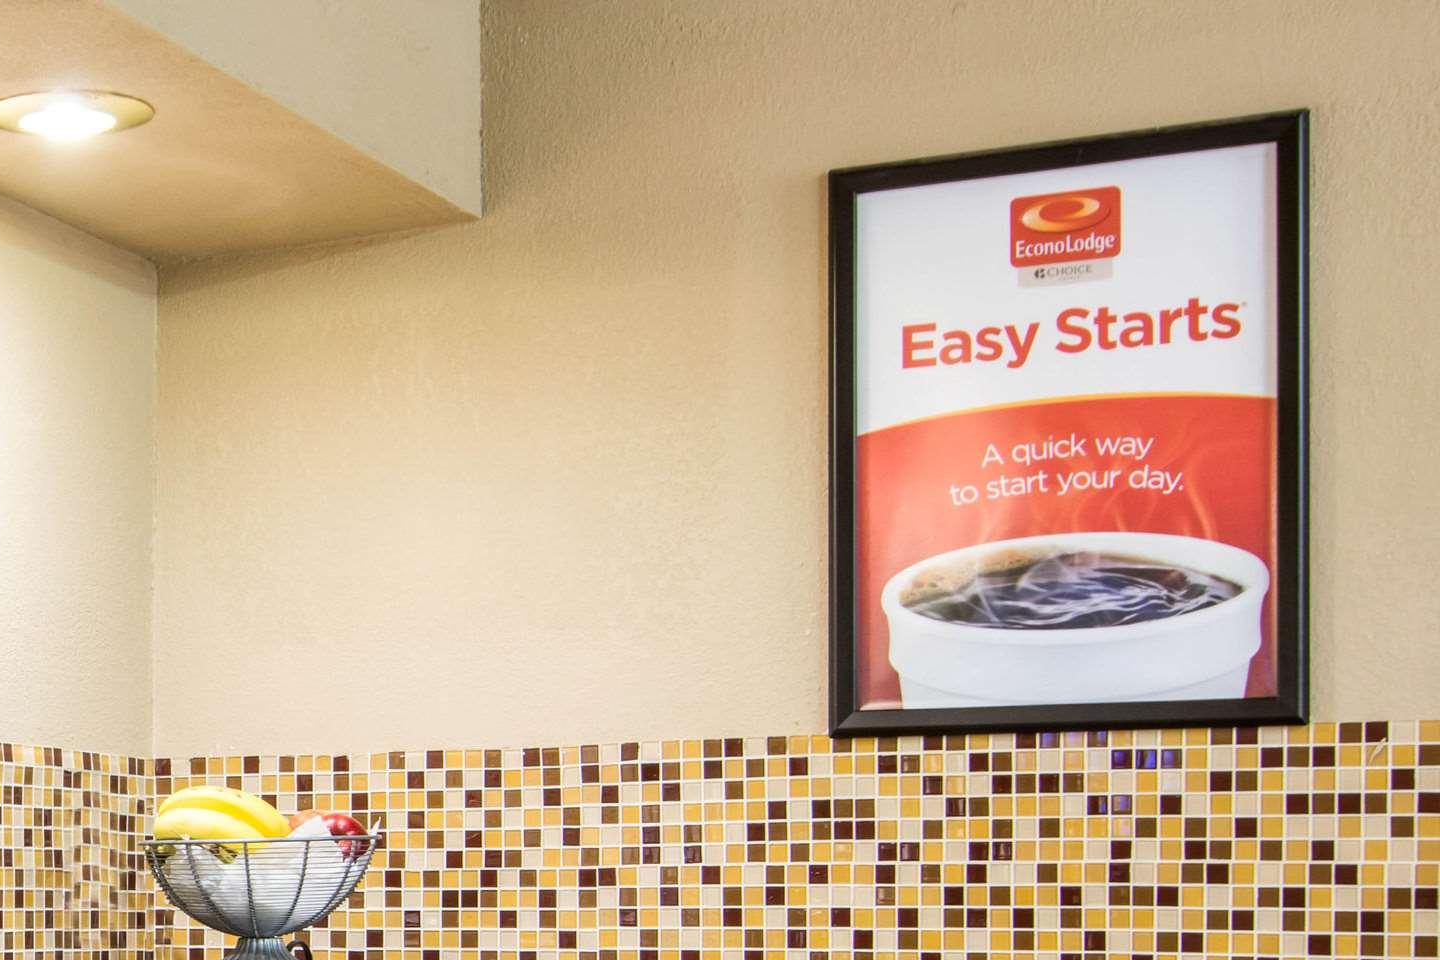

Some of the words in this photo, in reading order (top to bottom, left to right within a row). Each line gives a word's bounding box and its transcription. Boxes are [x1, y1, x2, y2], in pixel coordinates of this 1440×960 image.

[1015, 232, 1116, 258] EconoLodge
[901, 321, 1040, 369] Easy
[1055, 297, 1242, 354] Starts
[981, 443, 1004, 468] A
[1011, 433, 1087, 466] quick
[1095, 436, 1154, 460] way
[949, 483, 979, 506] to
[986, 469, 1048, 499] start
[1056, 468, 1122, 495] your
[1128, 464, 1185, 494] day.
